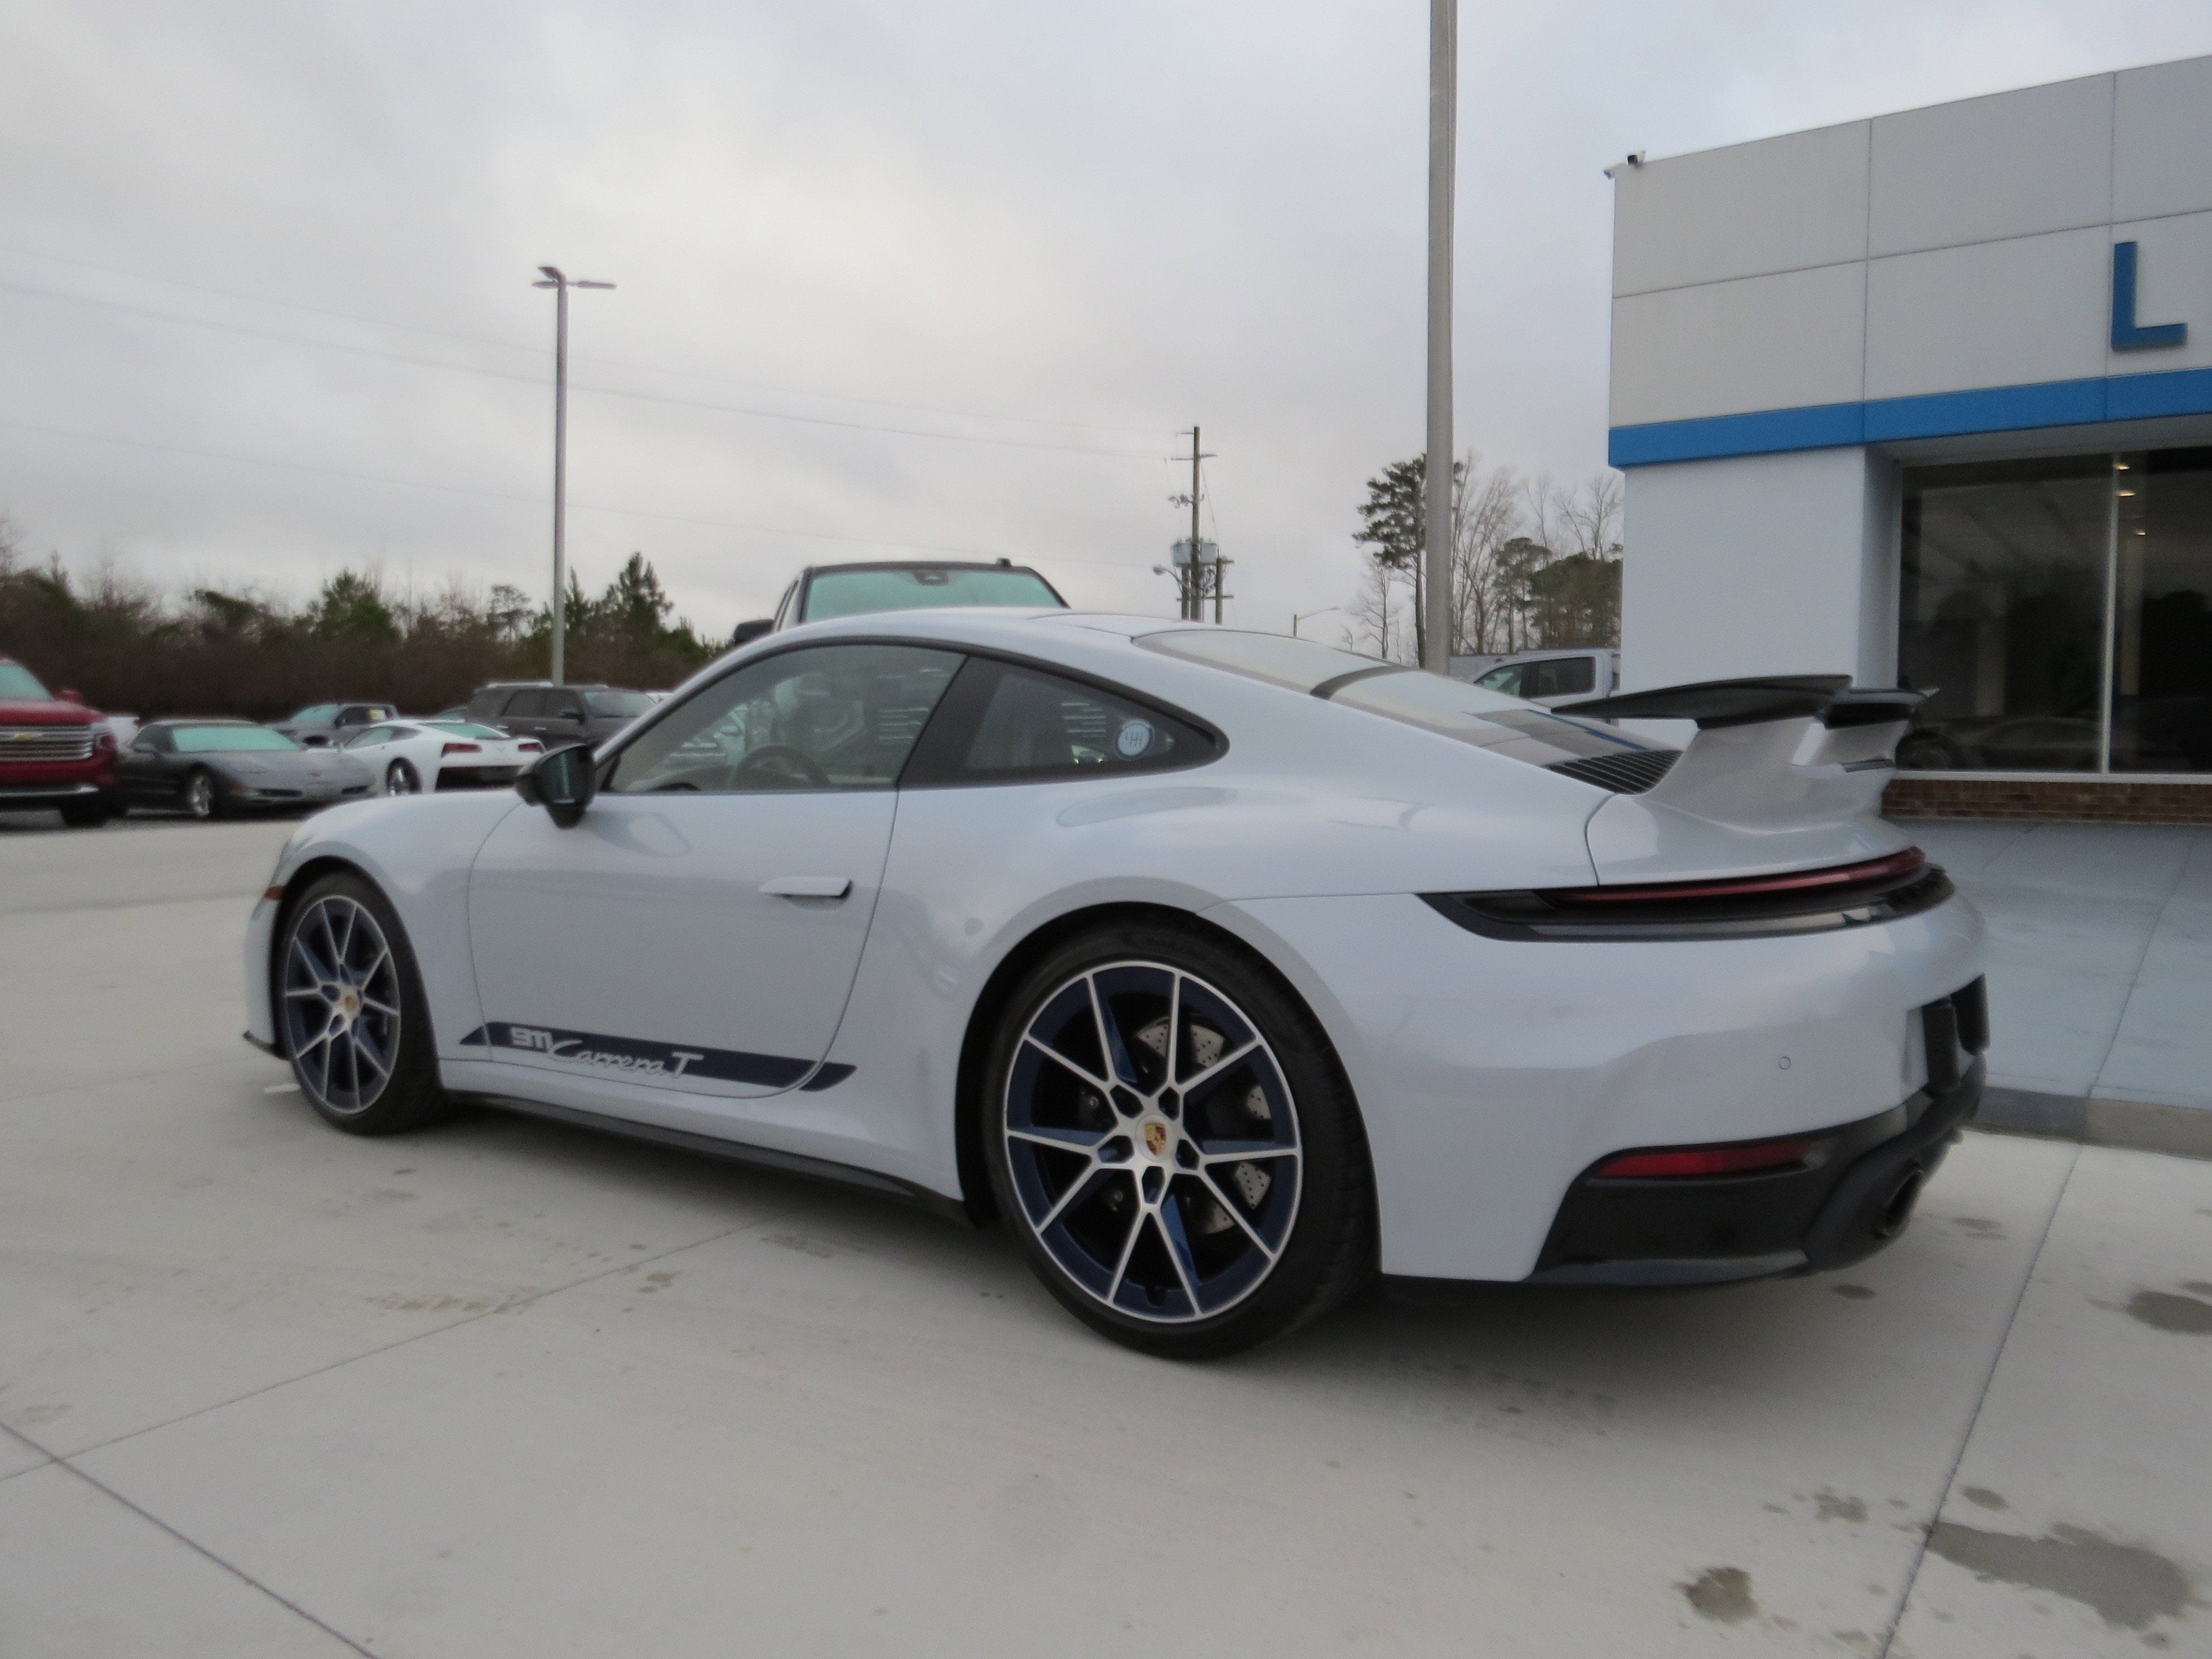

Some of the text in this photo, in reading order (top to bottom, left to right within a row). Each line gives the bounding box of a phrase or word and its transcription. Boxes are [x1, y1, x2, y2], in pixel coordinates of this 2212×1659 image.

[2111, 241, 2188, 349] L
[510, 1027, 705, 1078] 911 Carrera T
